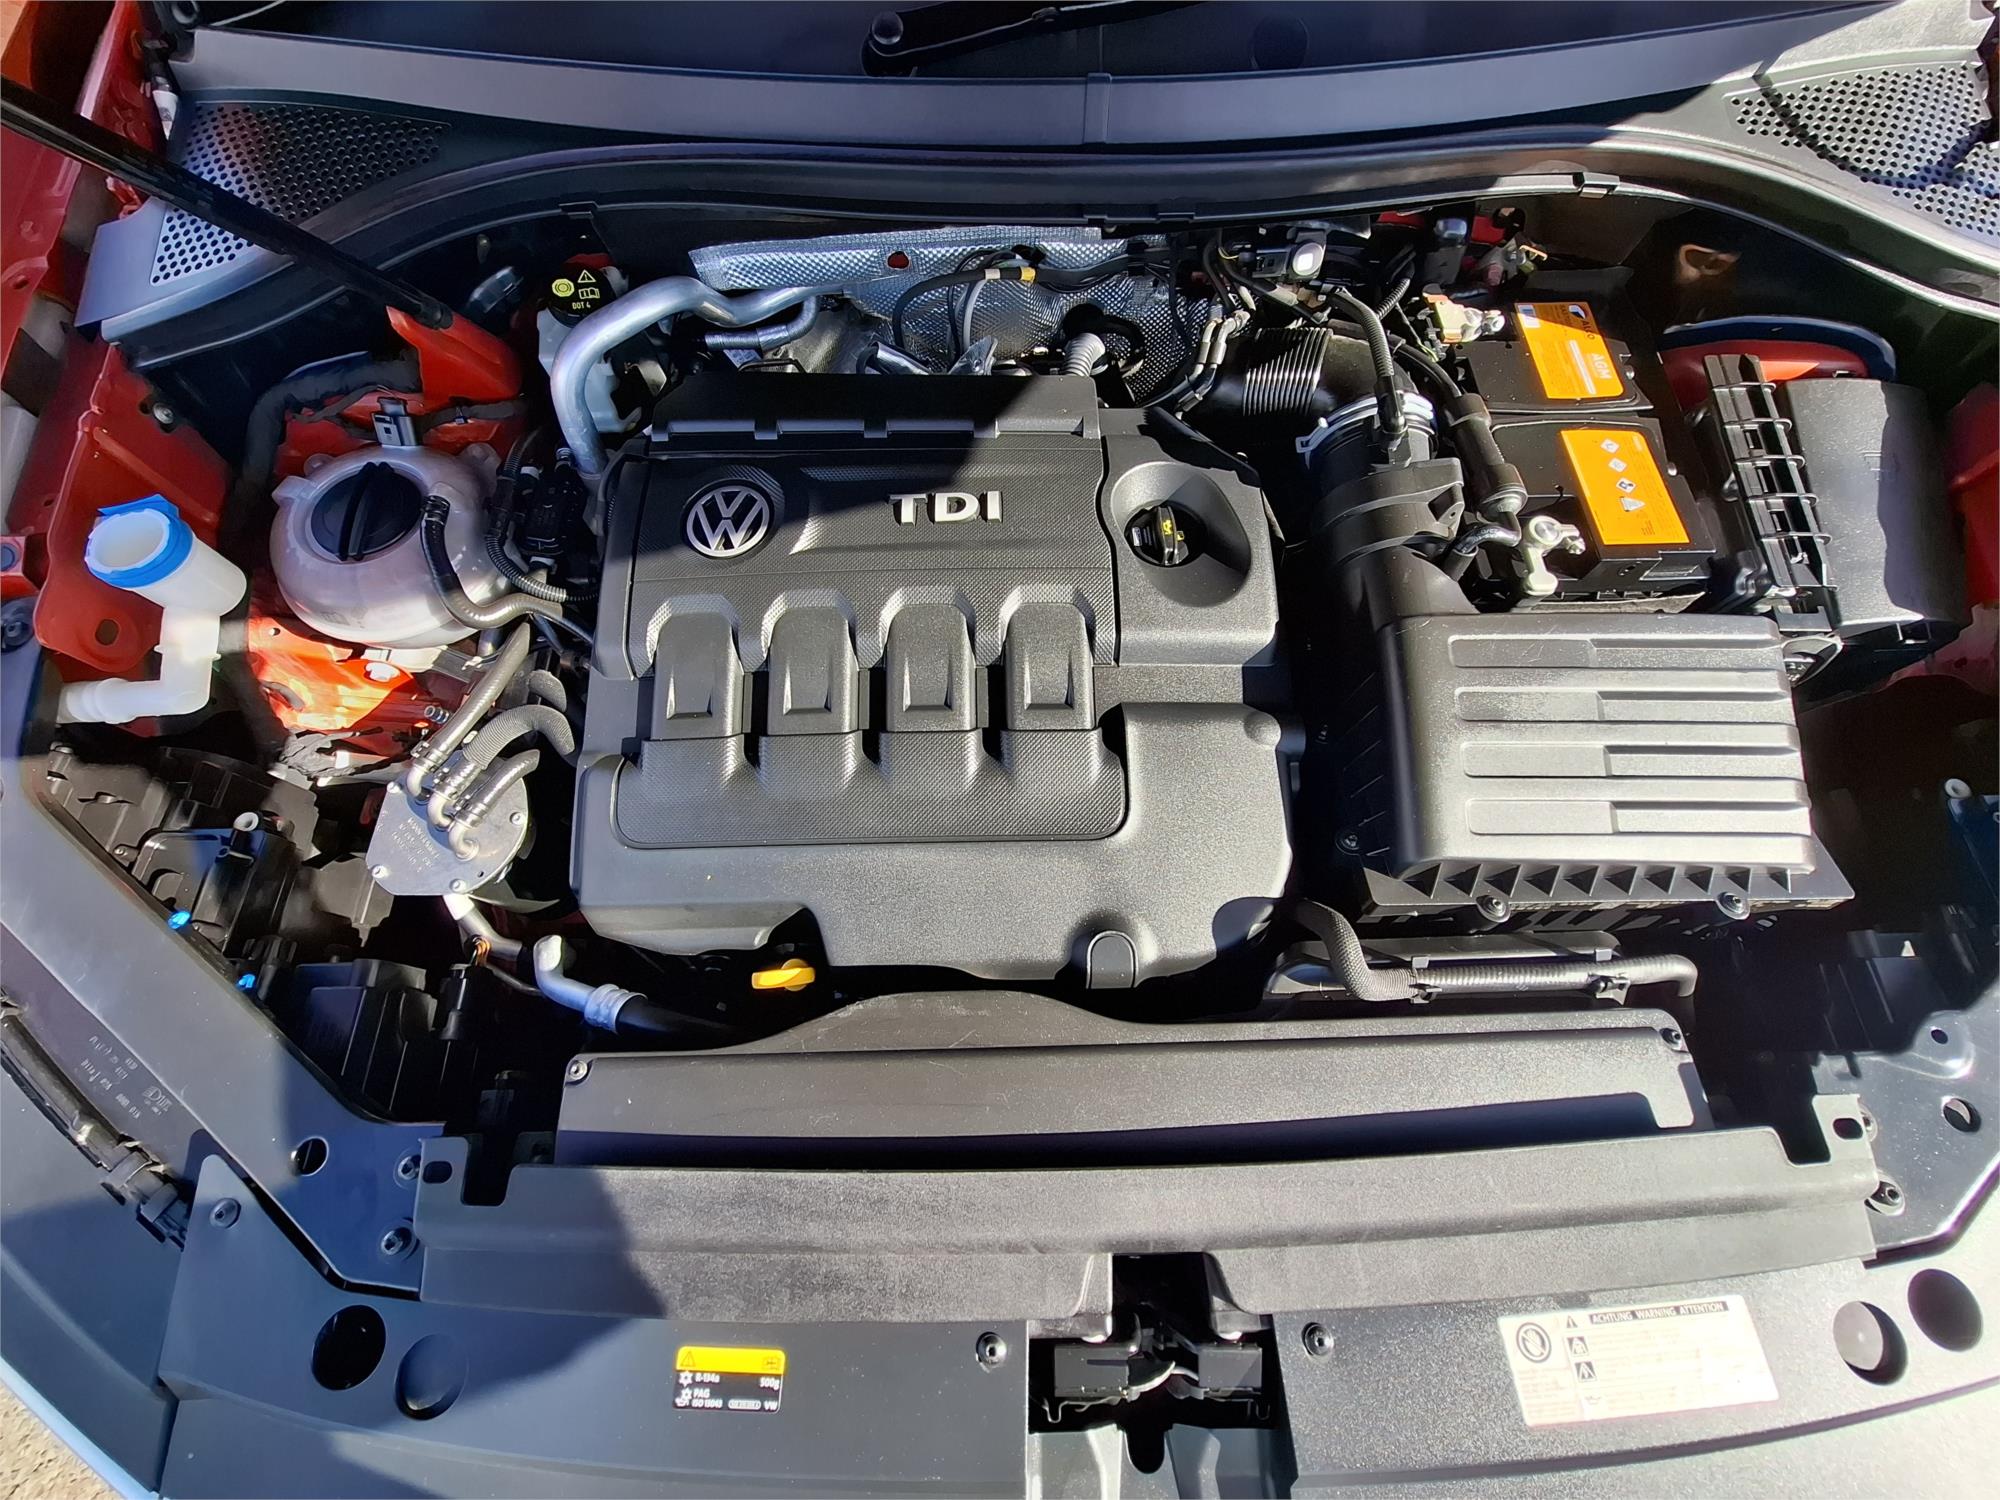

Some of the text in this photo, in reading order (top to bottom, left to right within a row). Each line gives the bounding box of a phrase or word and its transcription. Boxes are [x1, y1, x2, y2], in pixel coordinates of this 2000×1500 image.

[1591, 353, 1612, 378] AGM
[890, 490, 1002, 526] TDI
[1591, 1302, 1724, 1324] ACHTUNG WARNING ATTENTION
[693, 1388, 710, 1398] PAG
